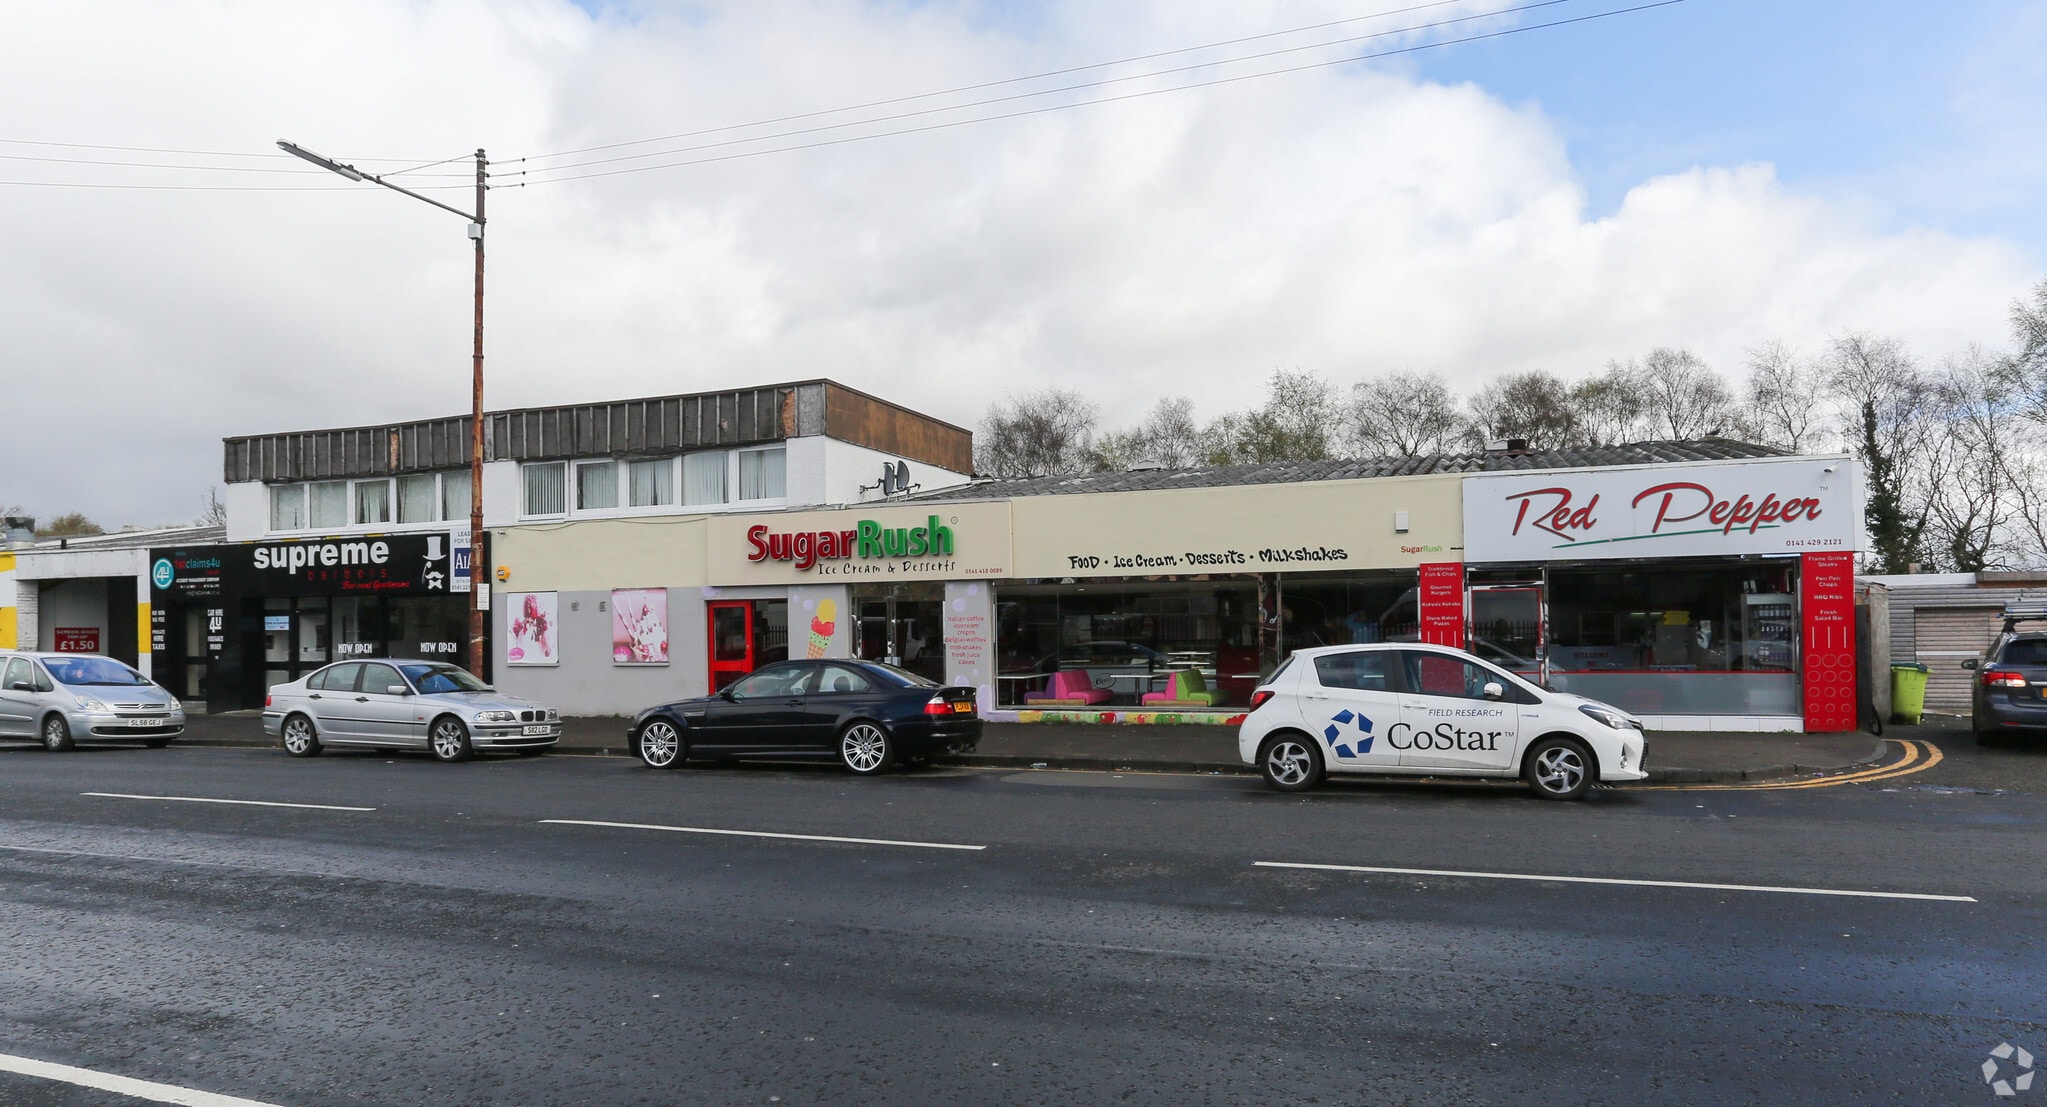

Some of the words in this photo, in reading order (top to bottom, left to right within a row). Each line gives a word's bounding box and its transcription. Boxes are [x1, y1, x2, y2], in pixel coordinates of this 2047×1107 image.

[1505, 487, 1600, 541] Red
[1632, 482, 1822, 536] Pepper
[747, 515, 954, 571] SugarRush
[1400, 545, 1442, 554] SugarRush
[253, 541, 389, 575] supreme
[1113, 555, 1133, 568] Ice
[1135, 554, 1177, 568] Cream
[1185, 550, 1246, 565] Desserts
[1258, 547, 1348, 562] Milkshakes
[819, 563, 837, 574] Ice
[843, 562, 881, 574] Cream
[888, 562, 896, 573] &
[903, 560, 956, 572] Desserts
[60, 640, 94, 650] £1.50
[338, 643, 353, 654] NOW
[355, 643, 372, 654] OPEN
[420, 642, 436, 653] NOW
[438, 642, 457, 652] OPEN
[1428, 708, 1452, 716] FIELD
[1455, 708, 1502, 716] RESEARCH
[1387, 722, 1502, 751] CoStar
